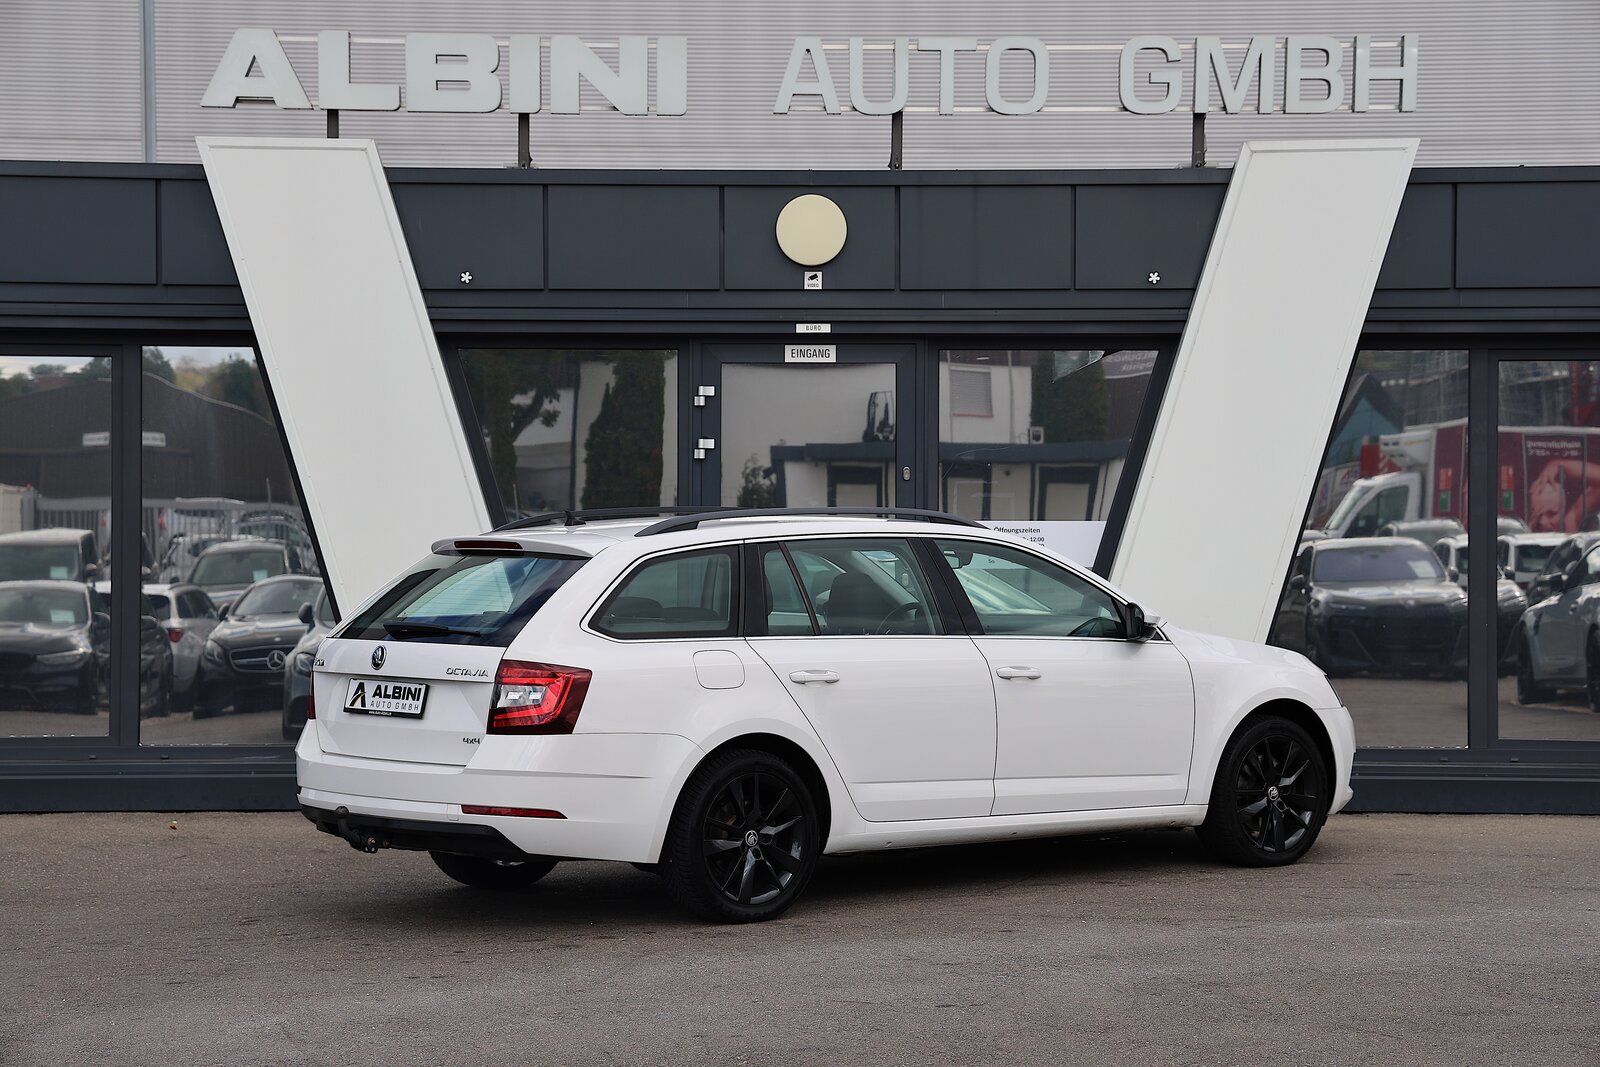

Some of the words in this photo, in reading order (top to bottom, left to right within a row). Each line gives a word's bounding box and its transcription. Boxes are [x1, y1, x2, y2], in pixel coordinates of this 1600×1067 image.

[201, 28, 687, 116] ALBINI
[773, 36, 1050, 115] AUTO
[1118, 35, 1419, 114] GMBH
[790, 348, 831, 358] EINGANG
[445, 667, 489, 677] OCTAVIA
[372, 684, 422, 702] ALBINI
[369, 700, 392, 710] AUTO
[395, 702, 420, 711] GMBH
